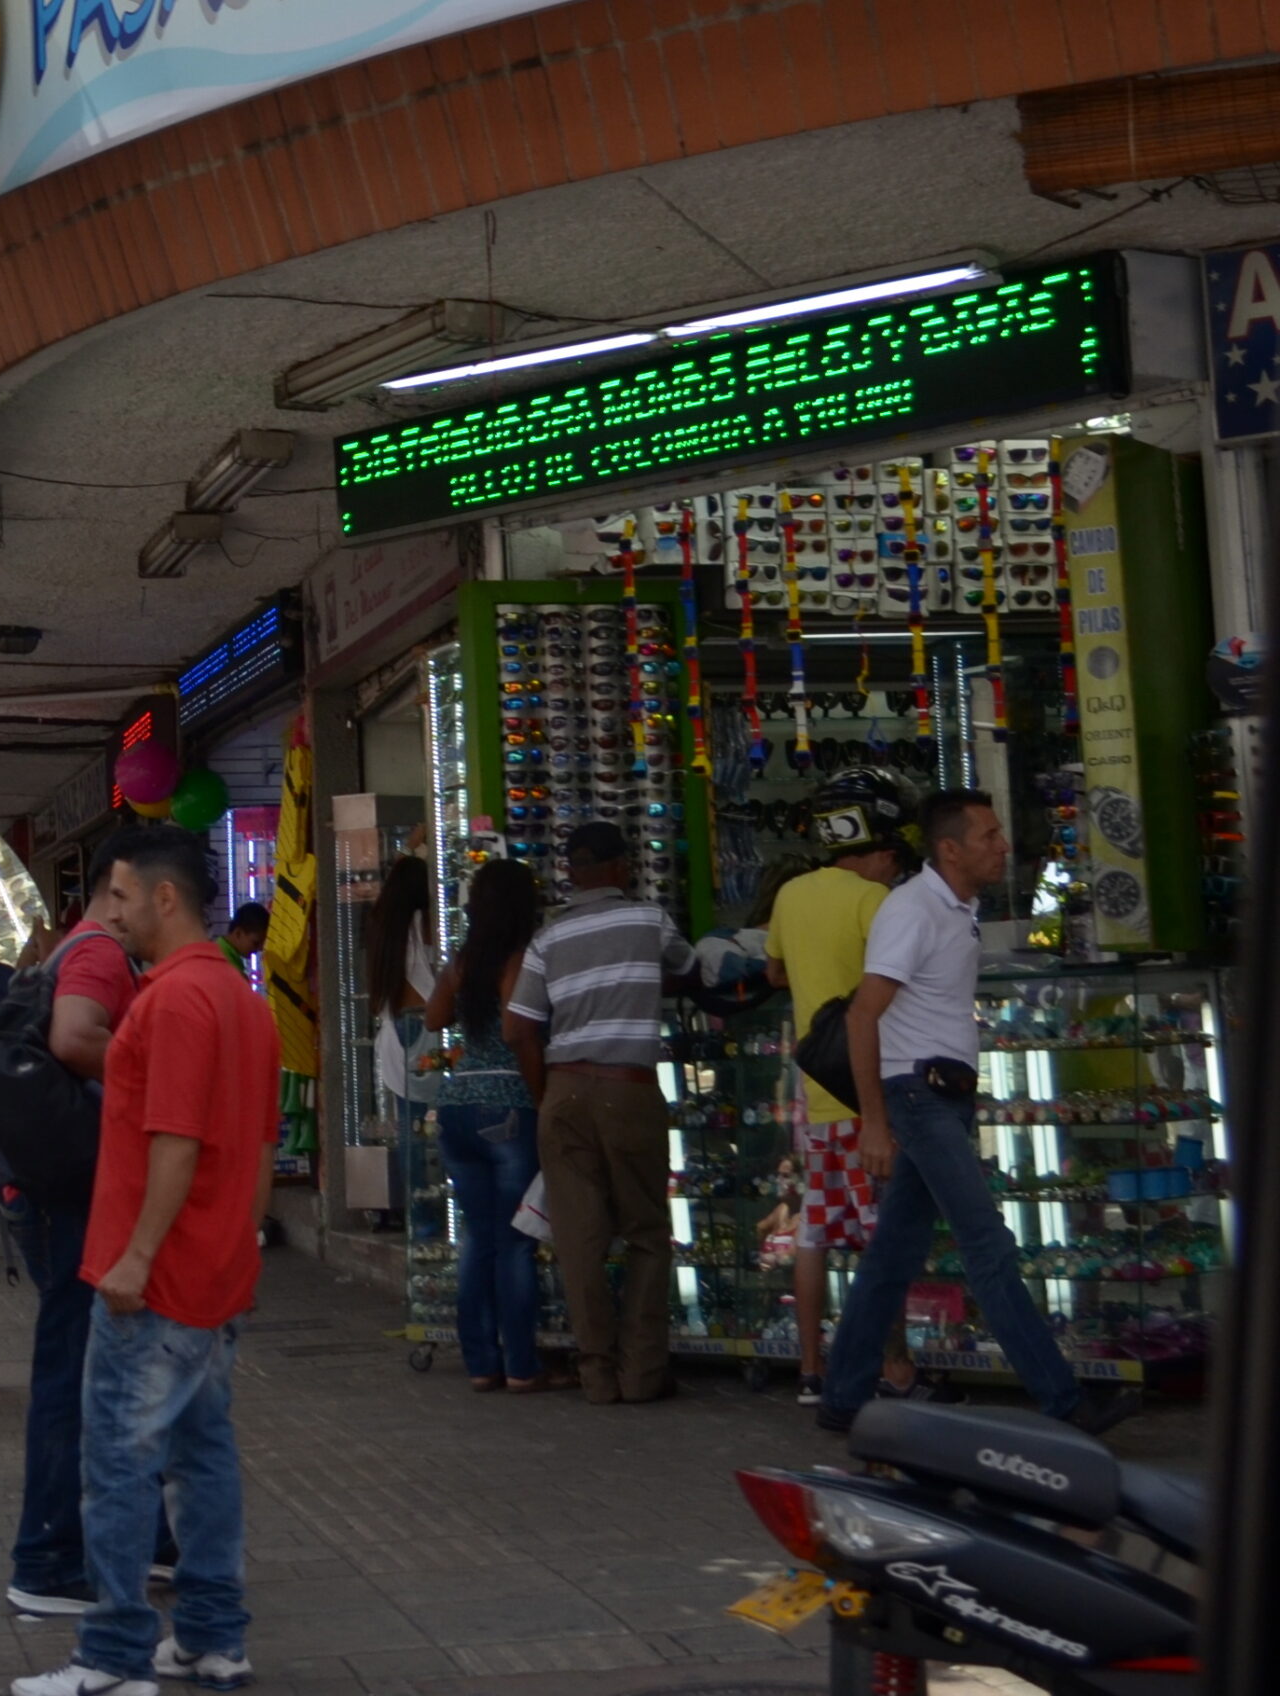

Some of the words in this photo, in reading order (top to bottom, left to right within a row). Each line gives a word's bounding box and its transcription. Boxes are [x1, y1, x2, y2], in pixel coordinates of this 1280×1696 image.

[1070, 525, 1116, 556] CAMBIO
[1087, 567, 1107, 595] DE
[1078, 604, 1122, 636] PILAS
[1085, 727, 1132, 742] ORIENT
[1087, 755, 1132, 767] CASIO
[977, 1448, 1069, 1491] auteco
